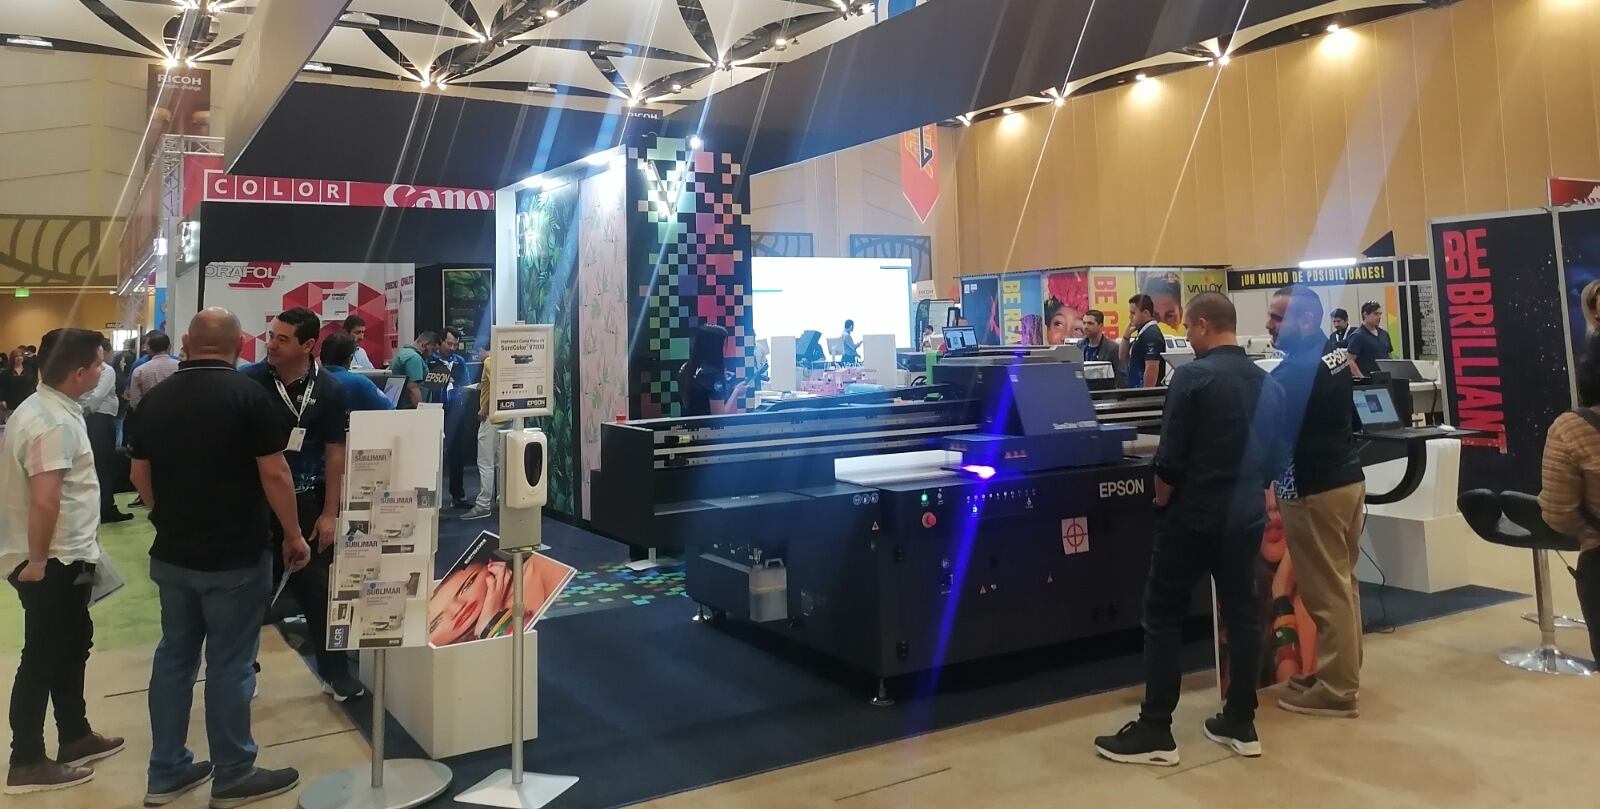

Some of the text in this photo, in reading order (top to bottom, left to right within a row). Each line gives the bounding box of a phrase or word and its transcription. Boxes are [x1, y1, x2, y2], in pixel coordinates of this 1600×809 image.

[157, 74, 202, 86] RICOH
[214, 179, 340, 199] COLOR
[384, 184, 495, 209] Cano
[1442, 228, 1491, 279] BE
[205, 264, 281, 279] ORAFOL
[1258, 271, 1289, 285] MUNDO
[1292, 270, 1304, 283] DE
[1307, 265, 1385, 283] POSIBILIDADES!
[1003, 281, 1021, 304] BE
[1094, 276, 1118, 304] BE
[425, 372, 450, 383] EPSON
[1446, 282, 1508, 454] BRILLIANT
[1099, 478, 1145, 498] EPSON
[344, 540, 378, 548] SUBLIMAR
[366, 587, 401, 595] SUBLIMAR
